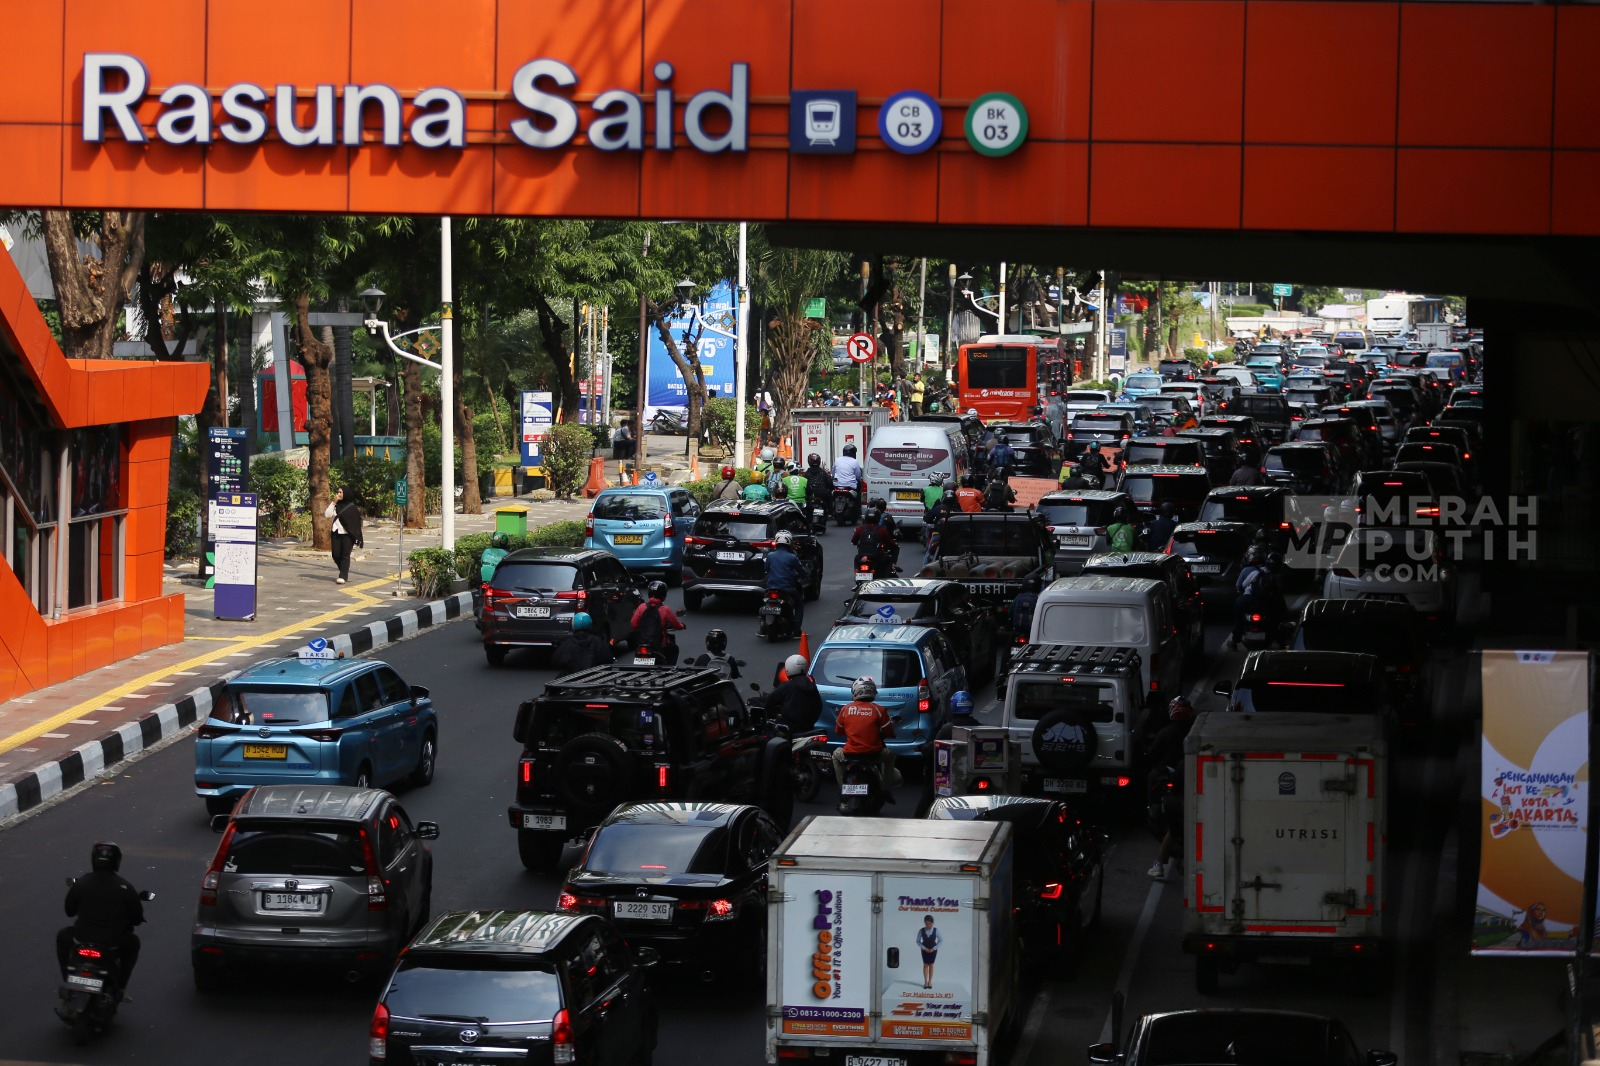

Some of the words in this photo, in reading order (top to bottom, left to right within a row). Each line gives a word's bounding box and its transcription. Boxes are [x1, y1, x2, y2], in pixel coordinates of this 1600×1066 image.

[82, 52, 467, 148] Rasuna
[510, 58, 749, 153] Said
[900, 106, 920, 118] CB
[986, 108, 1006, 120] BK
[897, 122, 922, 138] 03
[983, 125, 1008, 141] 03
[857, 340, 868, 356] P
[246, 745, 250, 753] B
[253, 746, 269, 754] 1542
[1500, 771, 1575, 784] PENCANANGAN
[1503, 784, 1522, 795] HUT
[1521, 797, 1549, 807] KOTA
[525, 816, 529, 824] B
[560, 817, 565, 825] T
[1275, 828, 1338, 839] UTRISI
[266, 894, 272, 904] B
[898, 895, 935, 907] Thank
[936, 896, 959, 907] You
[617, 904, 622, 912] B
[628, 904, 648, 913] 2229
[651, 905, 667, 914] SXG
[834, 890, 843, 925] Solutions
[833, 926, 843, 949] Office
[811, 889, 833, 1000] OfficePro
[833, 957, 841, 967] IT
[833, 981, 841, 999] Your
[800, 1010, 861, 1018] 0812-1000-2300
[943, 1011, 962, 1019] way!
[848, 1056, 853, 1066] B
